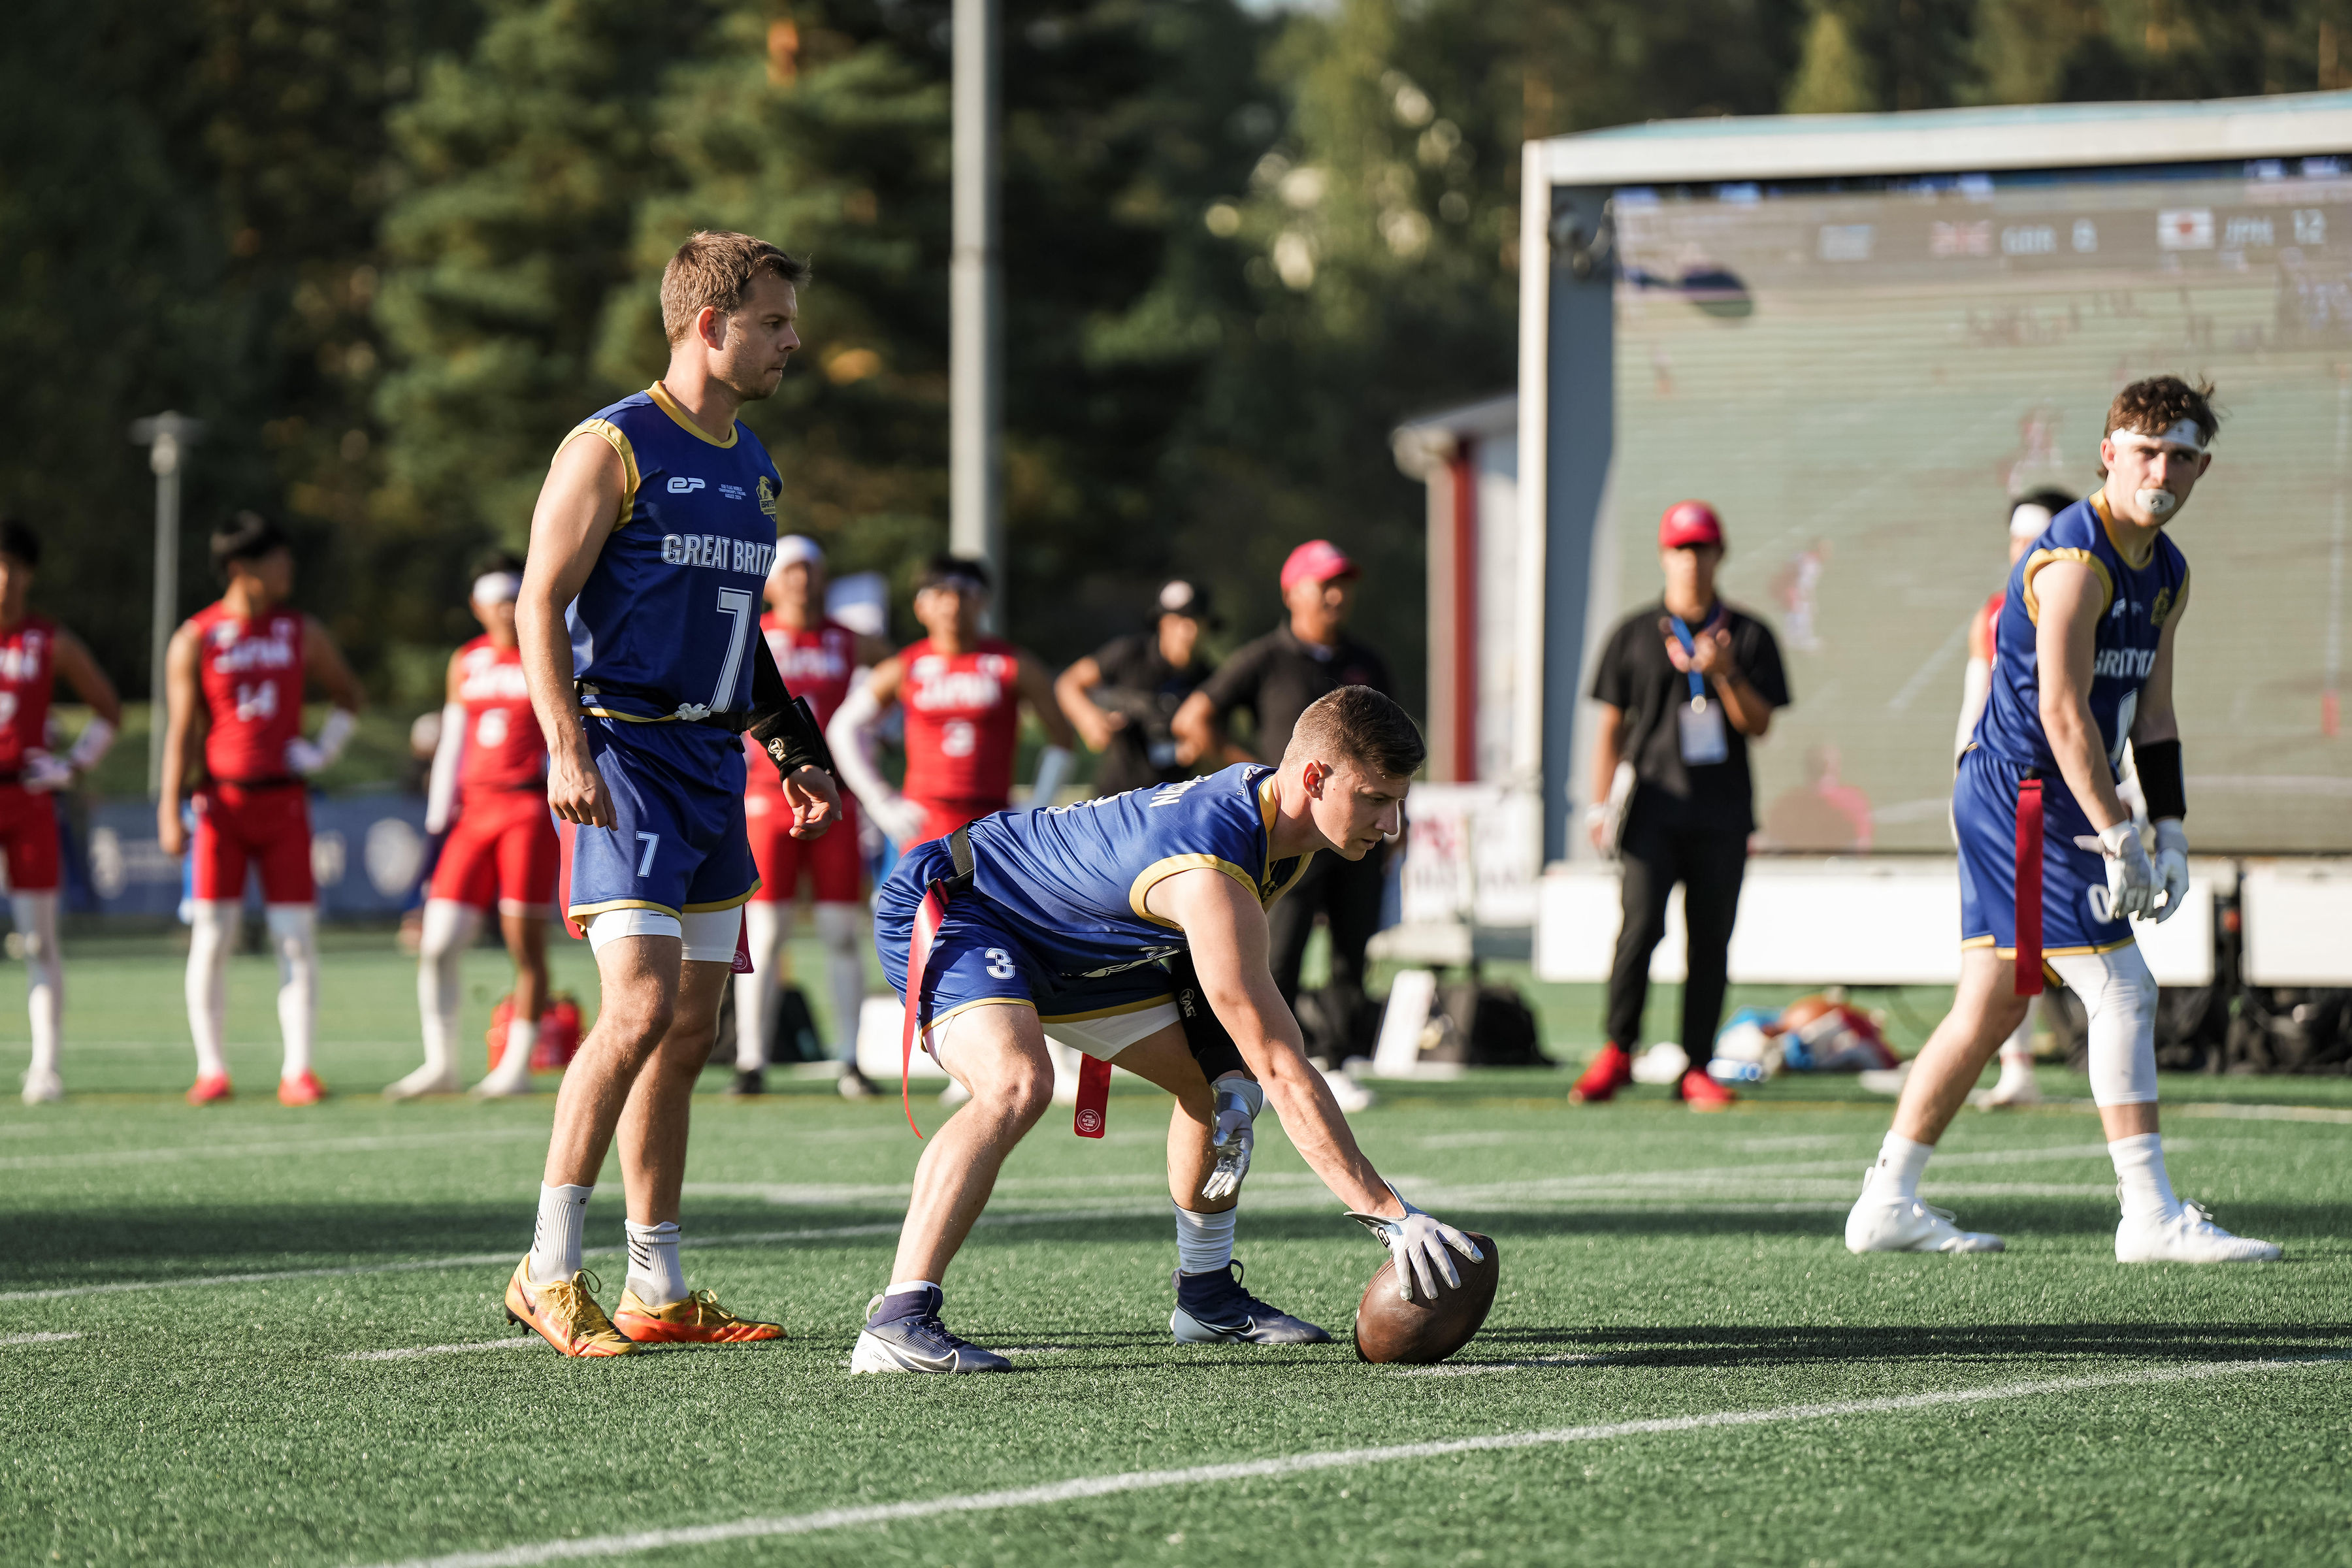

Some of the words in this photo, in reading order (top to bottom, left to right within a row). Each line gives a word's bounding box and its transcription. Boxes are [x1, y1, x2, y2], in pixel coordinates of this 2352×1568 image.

[661, 534, 730, 570] GREAT
[717, 587, 753, 714] 7
[636, 830, 659, 877] 7
[985, 947, 1015, 979] 3
